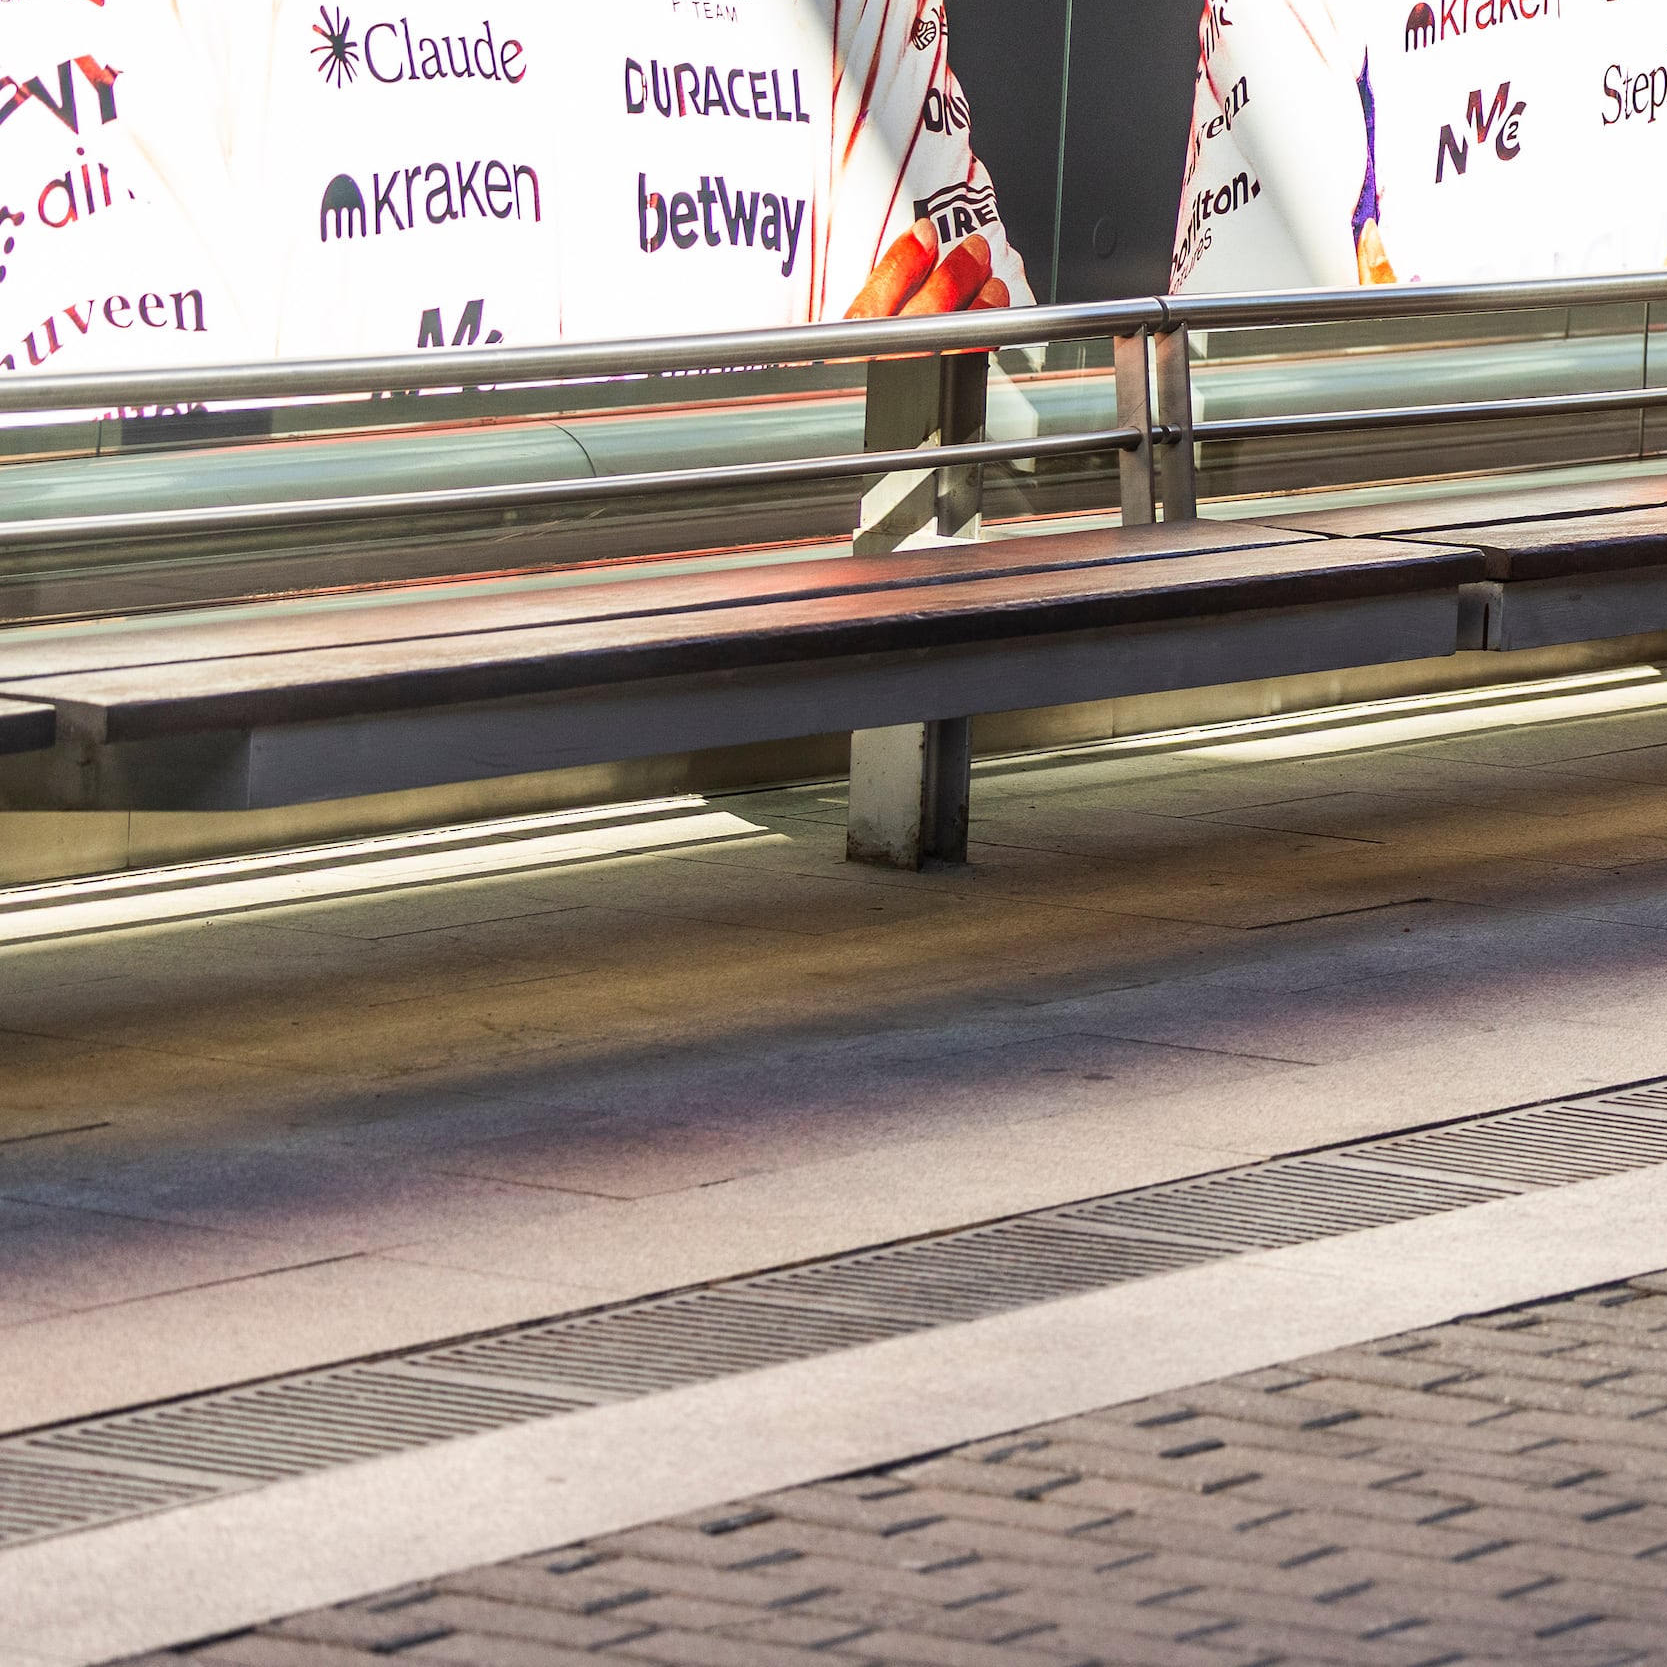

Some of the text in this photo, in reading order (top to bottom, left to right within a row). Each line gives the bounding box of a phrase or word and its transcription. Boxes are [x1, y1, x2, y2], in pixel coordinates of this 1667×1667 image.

[691, 0, 739, 24] TEAM
[364, 17, 527, 84] Claude
[624, 56, 811, 124] DURACELL
[373, 158, 541, 235] kraken
[637, 171, 806, 278] betway
